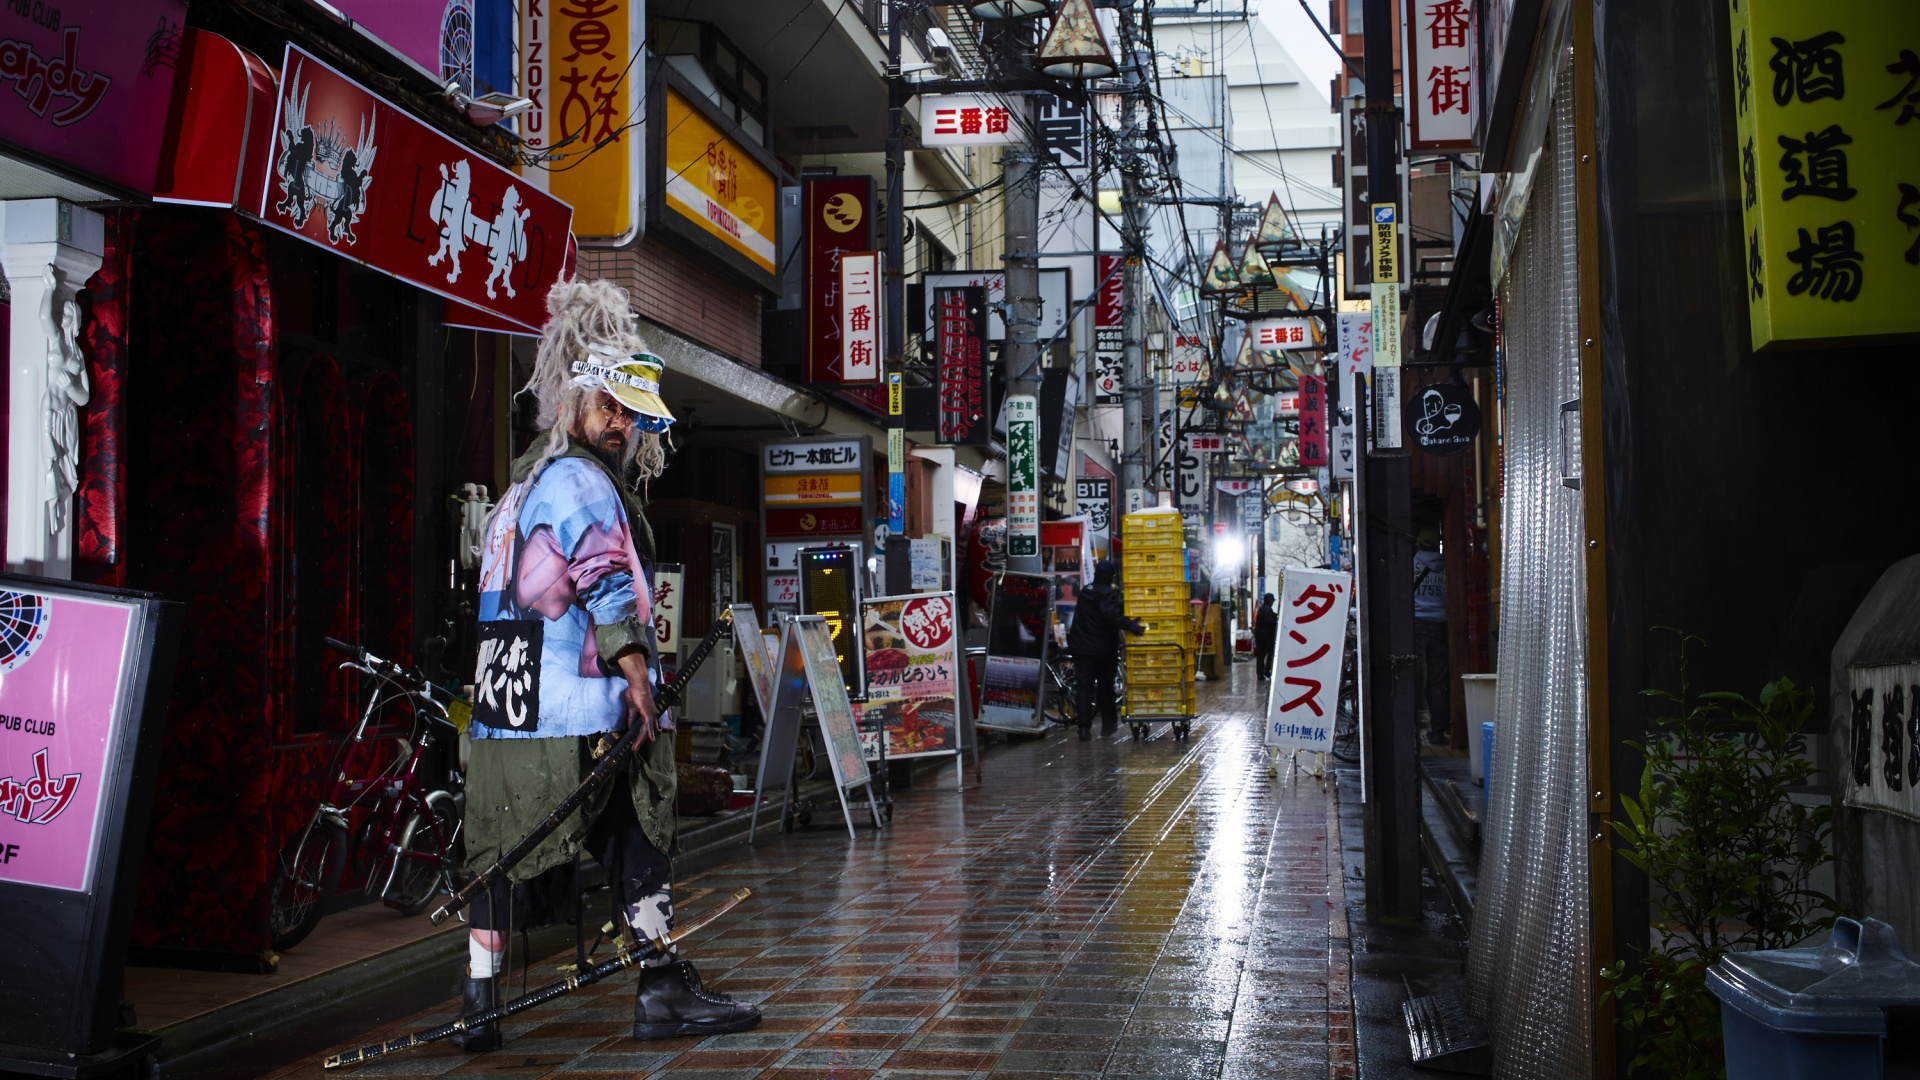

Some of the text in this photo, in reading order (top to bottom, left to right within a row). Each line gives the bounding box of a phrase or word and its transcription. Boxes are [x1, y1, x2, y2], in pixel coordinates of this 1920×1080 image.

[32, 0, 61, 32] CLUB
[934, 107, 1009, 135] 三番街
[1769, 31, 1863, 302] 酒道場
[406, 163, 546, 290] LEGEND
[1378, 223, 1393, 279] 防犯カメラ作動中
[848, 270, 873, 367] 三番街
[1260, 327, 1304, 344] 三番街
[1009, 402, 1033, 411] 不動産
[1017, 411, 1024, 419] の
[1009, 422, 1028, 487] マツザキ
[1192, 438, 1220, 449] 三番街
[1077, 483, 1107, 497] B1F
[903, 597, 948, 636] 焼肉
[915, 614, 951, 648] ランチ
[1280, 583, 1344, 717] ダンス
[0, 714, 56, 736] PUB CLUB
[1274, 722, 1327, 742] 年中無休
